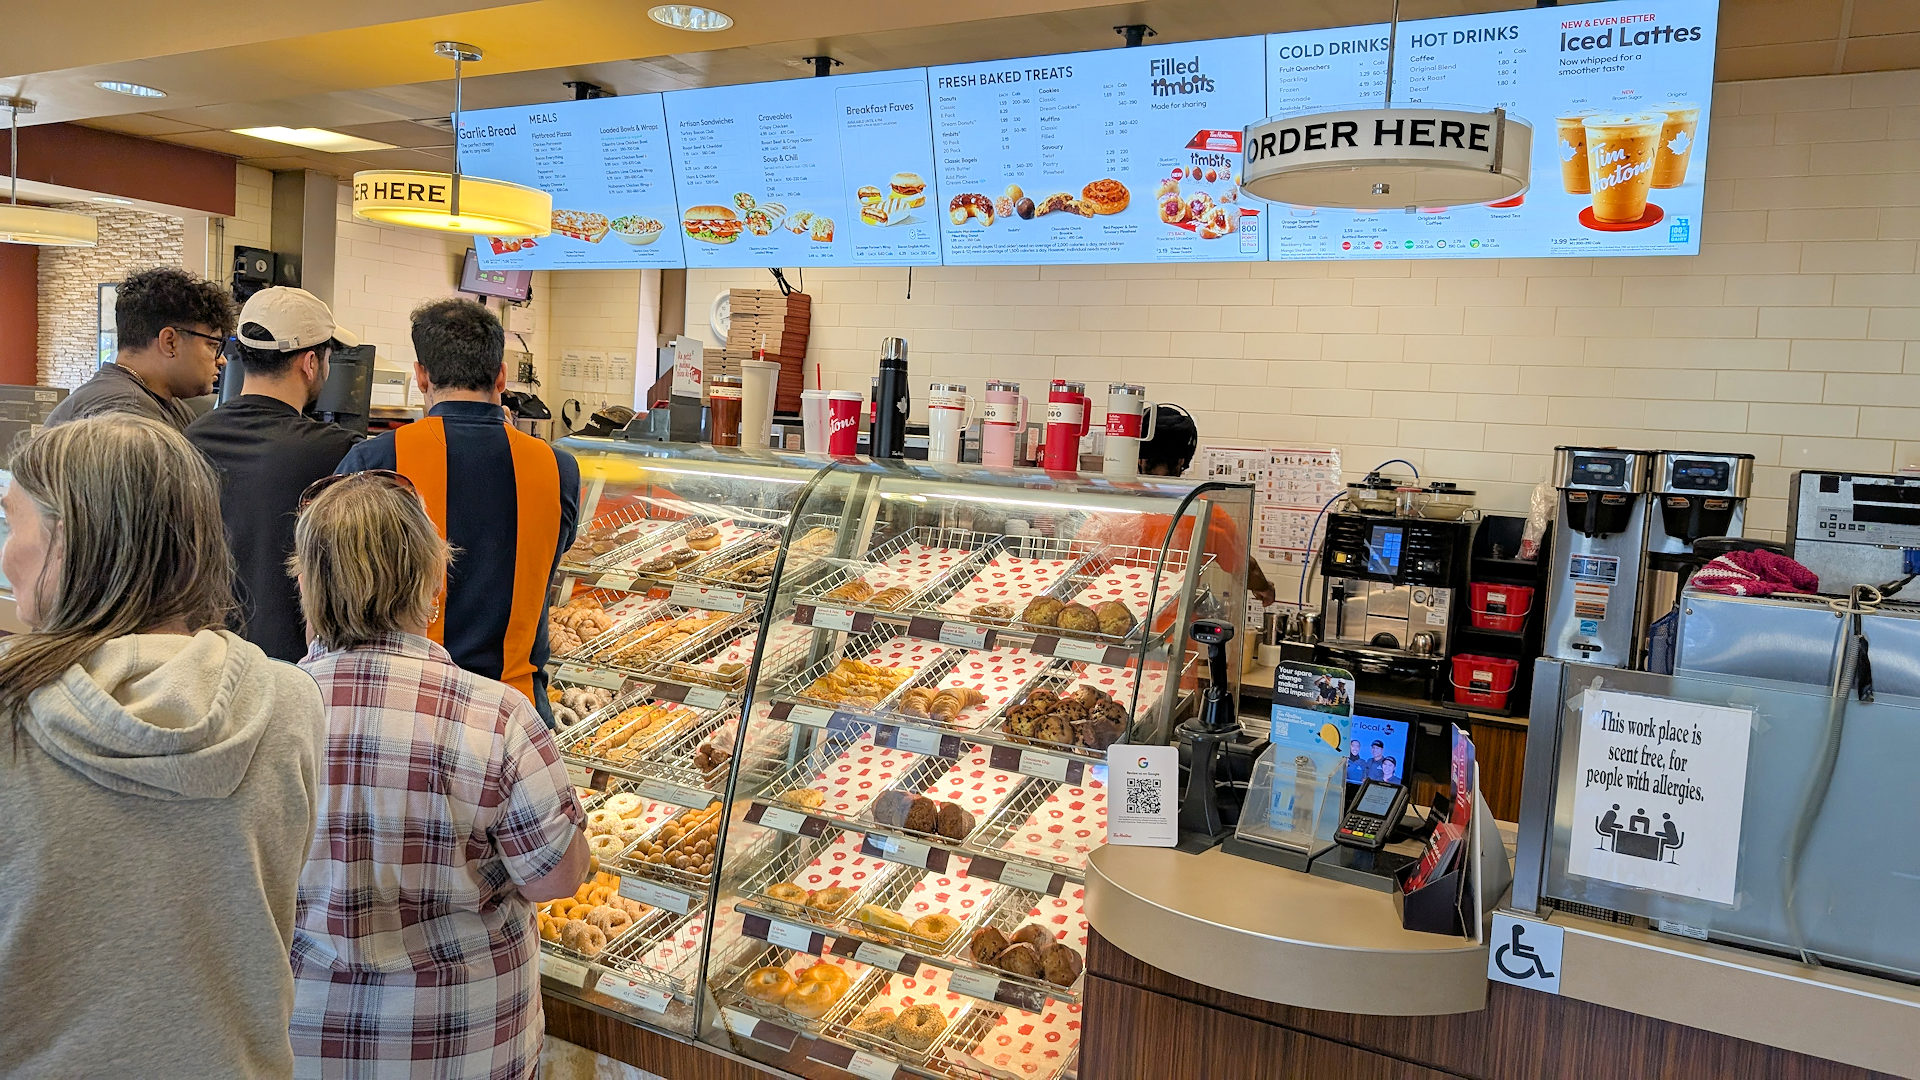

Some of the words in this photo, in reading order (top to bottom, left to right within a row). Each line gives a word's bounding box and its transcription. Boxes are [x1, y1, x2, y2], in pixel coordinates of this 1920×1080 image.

[1561, 21, 1582, 29] NEW
[1593, 17, 1618, 26] EVEN
[1620, 14, 1656, 24] BETTER
[1411, 32, 1448, 48] HOT
[1453, 26, 1519, 44] DRINKS
[1560, 27, 1613, 52] Iced
[1619, 24, 1701, 47] Lattes
[1280, 44, 1324, 59] COLD
[1329, 37, 1389, 55] DRINKS
[1150, 56, 1199, 77] Filled
[1560, 58, 1578, 66] Now
[1580, 55, 1618, 66] whipped
[1620, 53, 1633, 62] for
[939, 75, 976, 88] FRESH
[980, 71, 1022, 85] BAKED
[1024, 66, 1073, 81] TREATS
[1558, 66, 1600, 76] smoother
[1603, 64, 1625, 73] taste
[1151, 74, 1215, 96] timbits
[846, 104, 887, 115] Breakfast
[889, 103, 914, 112] Faves
[1181, 101, 1206, 110] sharing
[529, 113, 558, 124] MEALS
[700, 118, 734, 126] Sandwiches
[758, 113, 792, 121] Craveables
[459, 127, 486, 139] Garlic
[488, 124, 517, 137] Bread
[1247, 120, 1358, 164] ORDER
[1374, 118, 1490, 153] HERE
[1190, 152, 1232, 168] timbits
[1591, 142, 1626, 169] Tim
[1591, 157, 1653, 196] Hortons
[374, 182, 446, 203] HERE
[1279, 666, 1293, 674] Your
[1278, 674, 1302, 683] change
[1278, 681, 1298, 689] makes
[1290, 688, 1314, 698] impact!
[1359, 721, 1380, 731] local
[1601, 709, 1624, 734] This
[1628, 717, 1655, 738] work
[1658, 720, 1689, 745] place
[1692, 723, 1702, 745] is
[1608, 745, 1638, 764] scent
[1640, 745, 1666, 772] free,
[1669, 749, 1688, 772] for
[1586, 766, 1623, 791] people
[1627, 770, 1650, 792] with
[1652, 774, 1704, 805] allergies.
